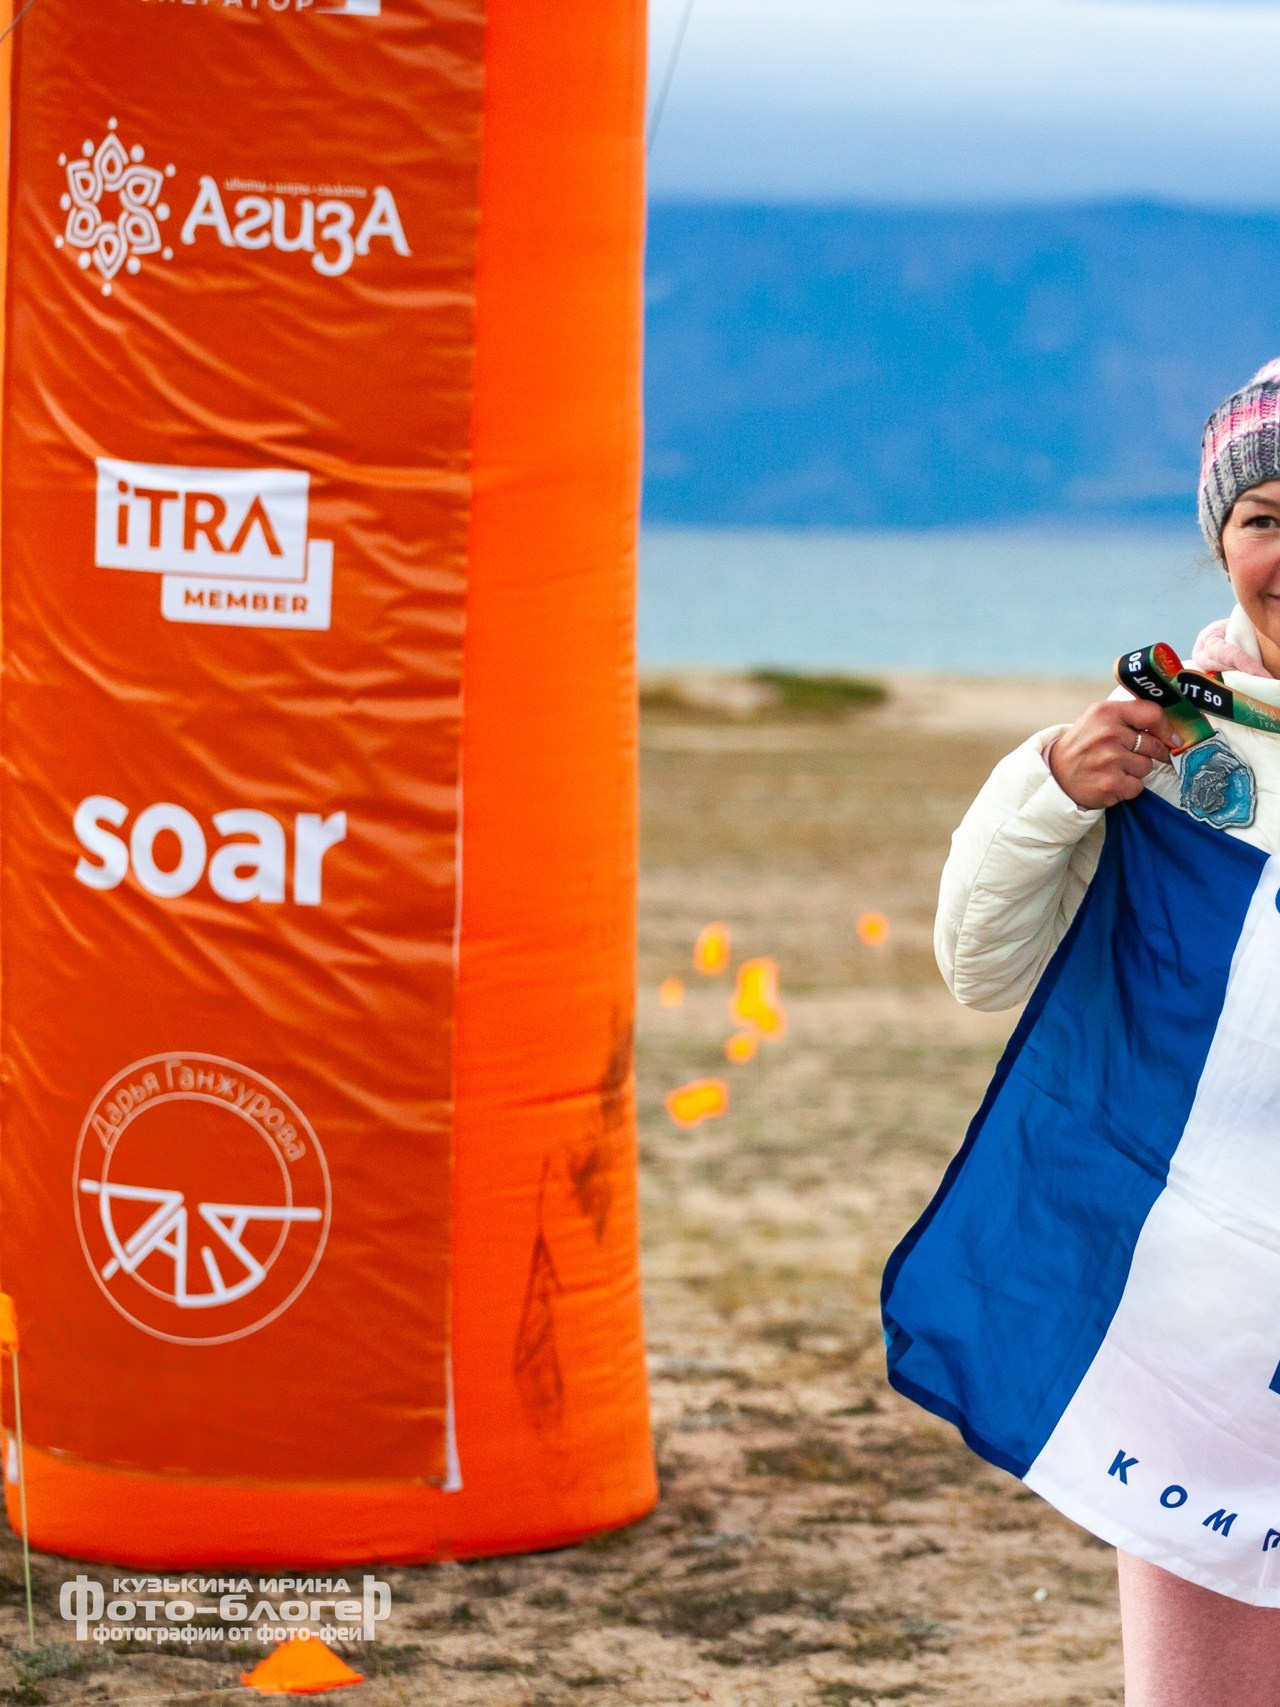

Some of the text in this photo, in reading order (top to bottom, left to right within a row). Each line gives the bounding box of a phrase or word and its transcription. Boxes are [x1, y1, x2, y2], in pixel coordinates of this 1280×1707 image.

[117, 479, 283, 557] iTRA
[184, 588, 308, 614] MEMBER
[1128, 651, 1164, 697] OUT 50
[1177, 682, 1222, 707] UT 50
[73, 794, 347, 907] soar
[90, 1058, 307, 1162] Дарья Ганжурова
